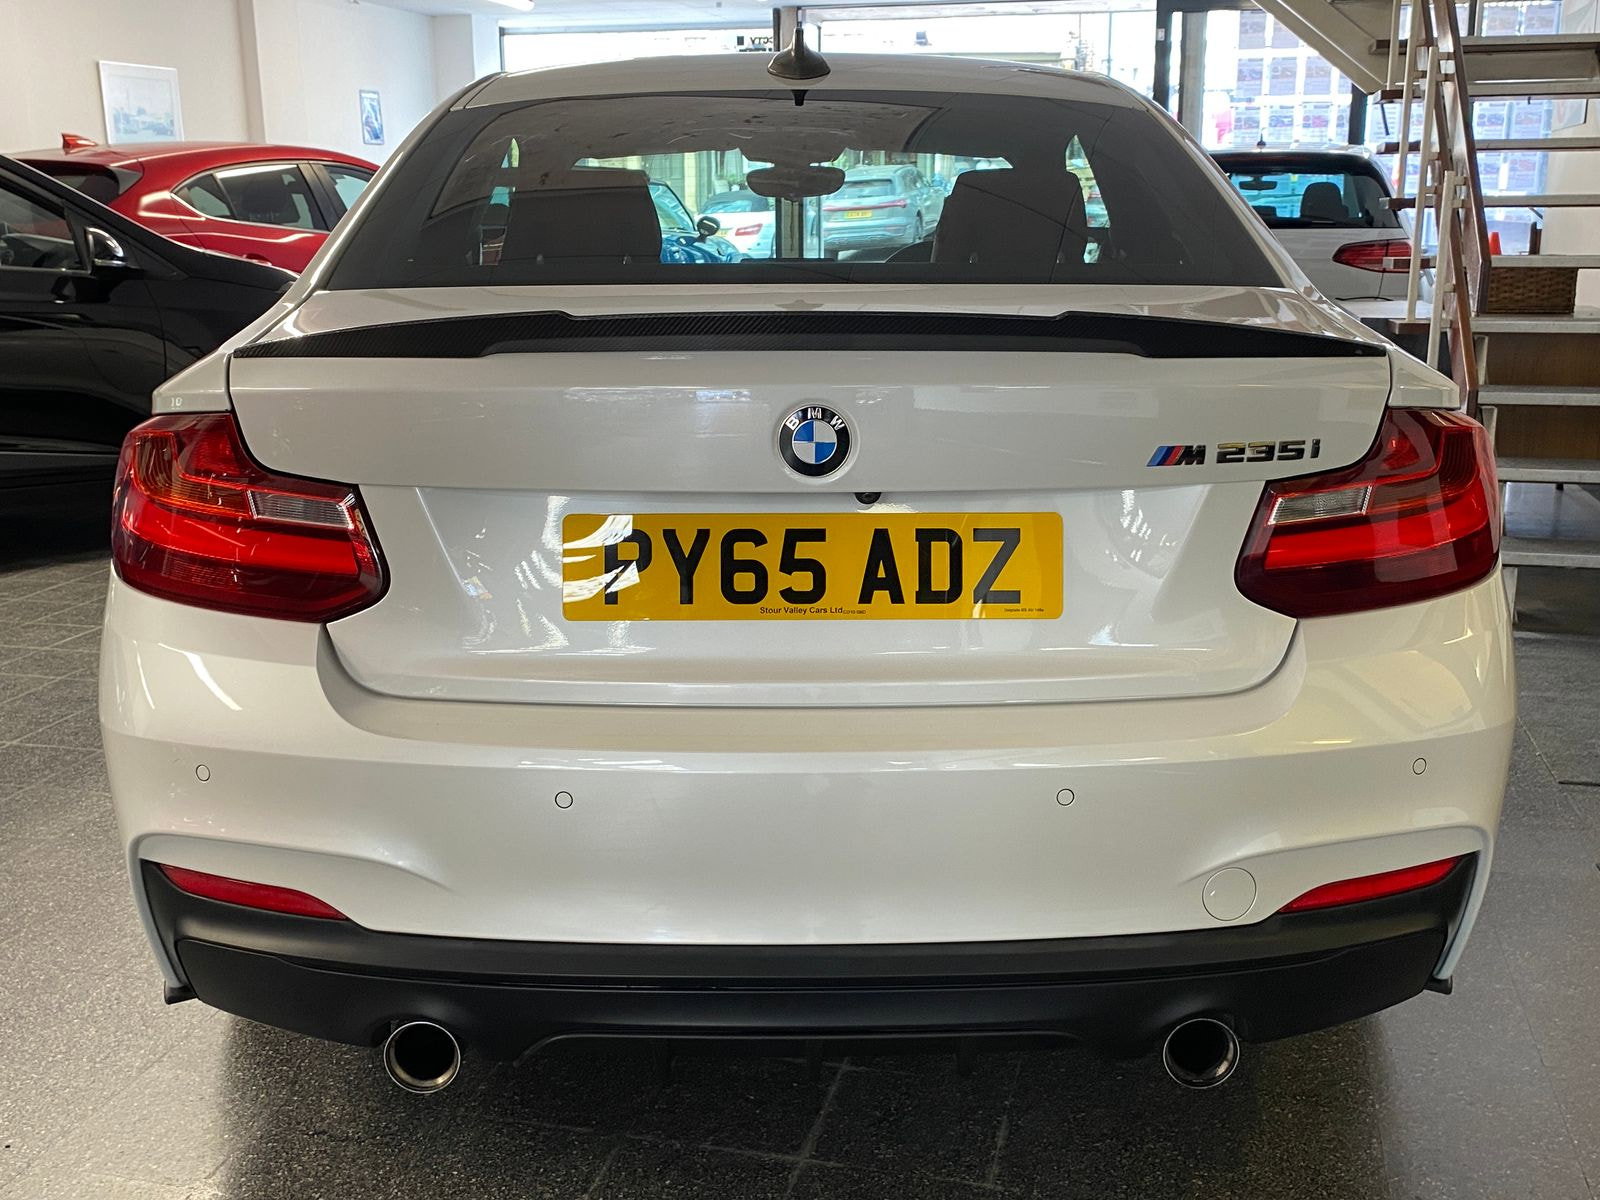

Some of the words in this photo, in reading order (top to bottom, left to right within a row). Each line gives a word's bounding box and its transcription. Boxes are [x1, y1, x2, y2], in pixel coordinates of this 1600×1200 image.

[784, 407, 846, 431] BMW
[604, 527, 828, 606] PY65
[857, 527, 1022, 606] ADZ
[759, 606, 781, 614] Stour
[783, 606, 807, 616] Valley
[809, 606, 828, 614] Cars
[829, 606, 843, 614] Ltd
